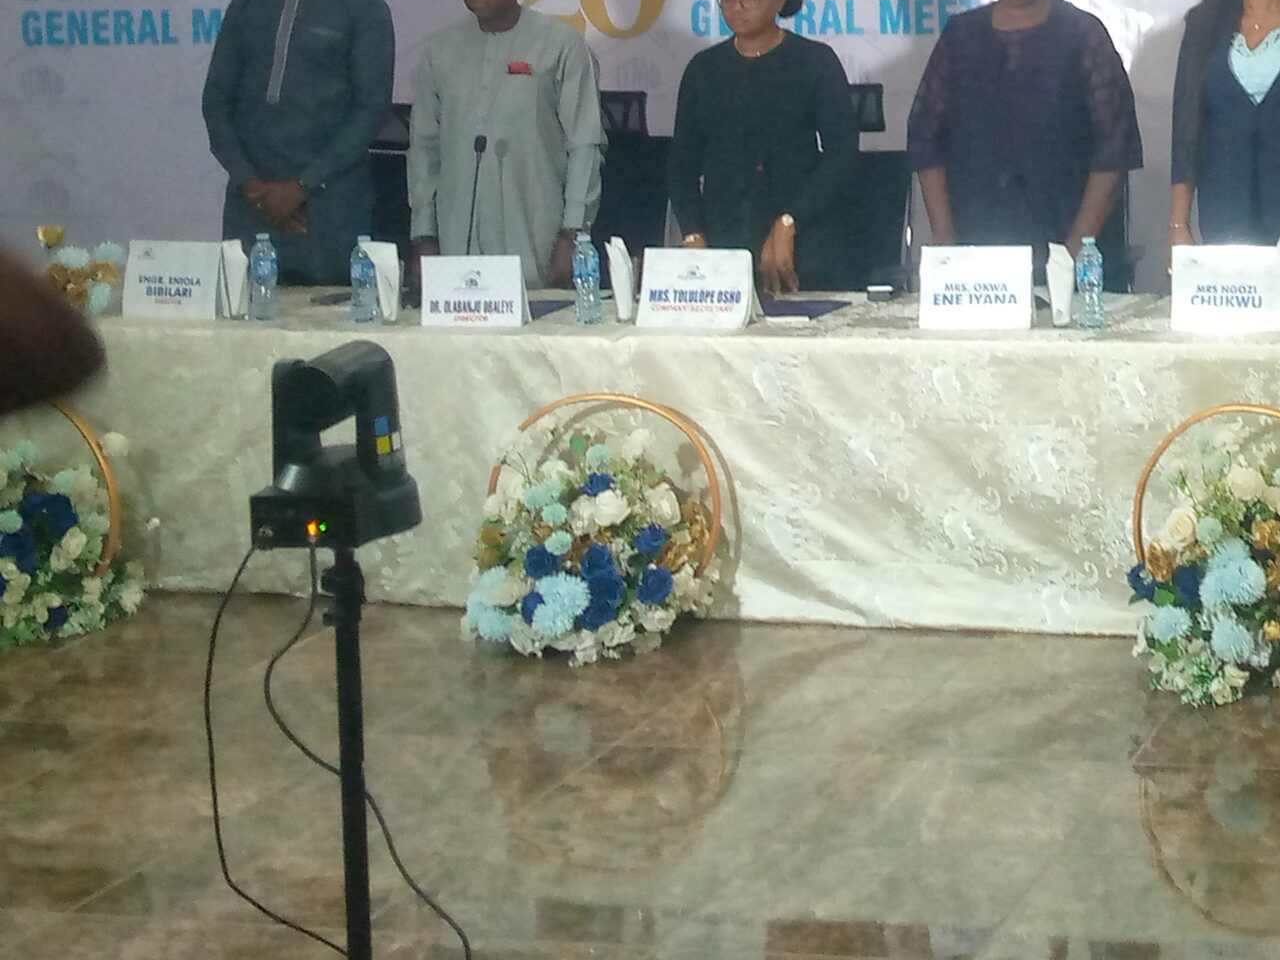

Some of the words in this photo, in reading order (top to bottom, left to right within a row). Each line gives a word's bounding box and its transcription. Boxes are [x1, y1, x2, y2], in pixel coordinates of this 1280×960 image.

[21, 8, 180, 46] GENERAL
[169, 276, 201, 287] ENIOLA
[973, 282, 1008, 292] OKWA
[146, 286, 192, 298] BIBILARI
[1221, 284, 1257, 295] NGOZI
[673, 289, 715, 303] TOLULOPE
[717, 290, 742, 304] OSHO
[933, 293, 962, 306] ENE
[969, 293, 1017, 305] IYANA
[1190, 294, 1263, 309] CHUKWU
